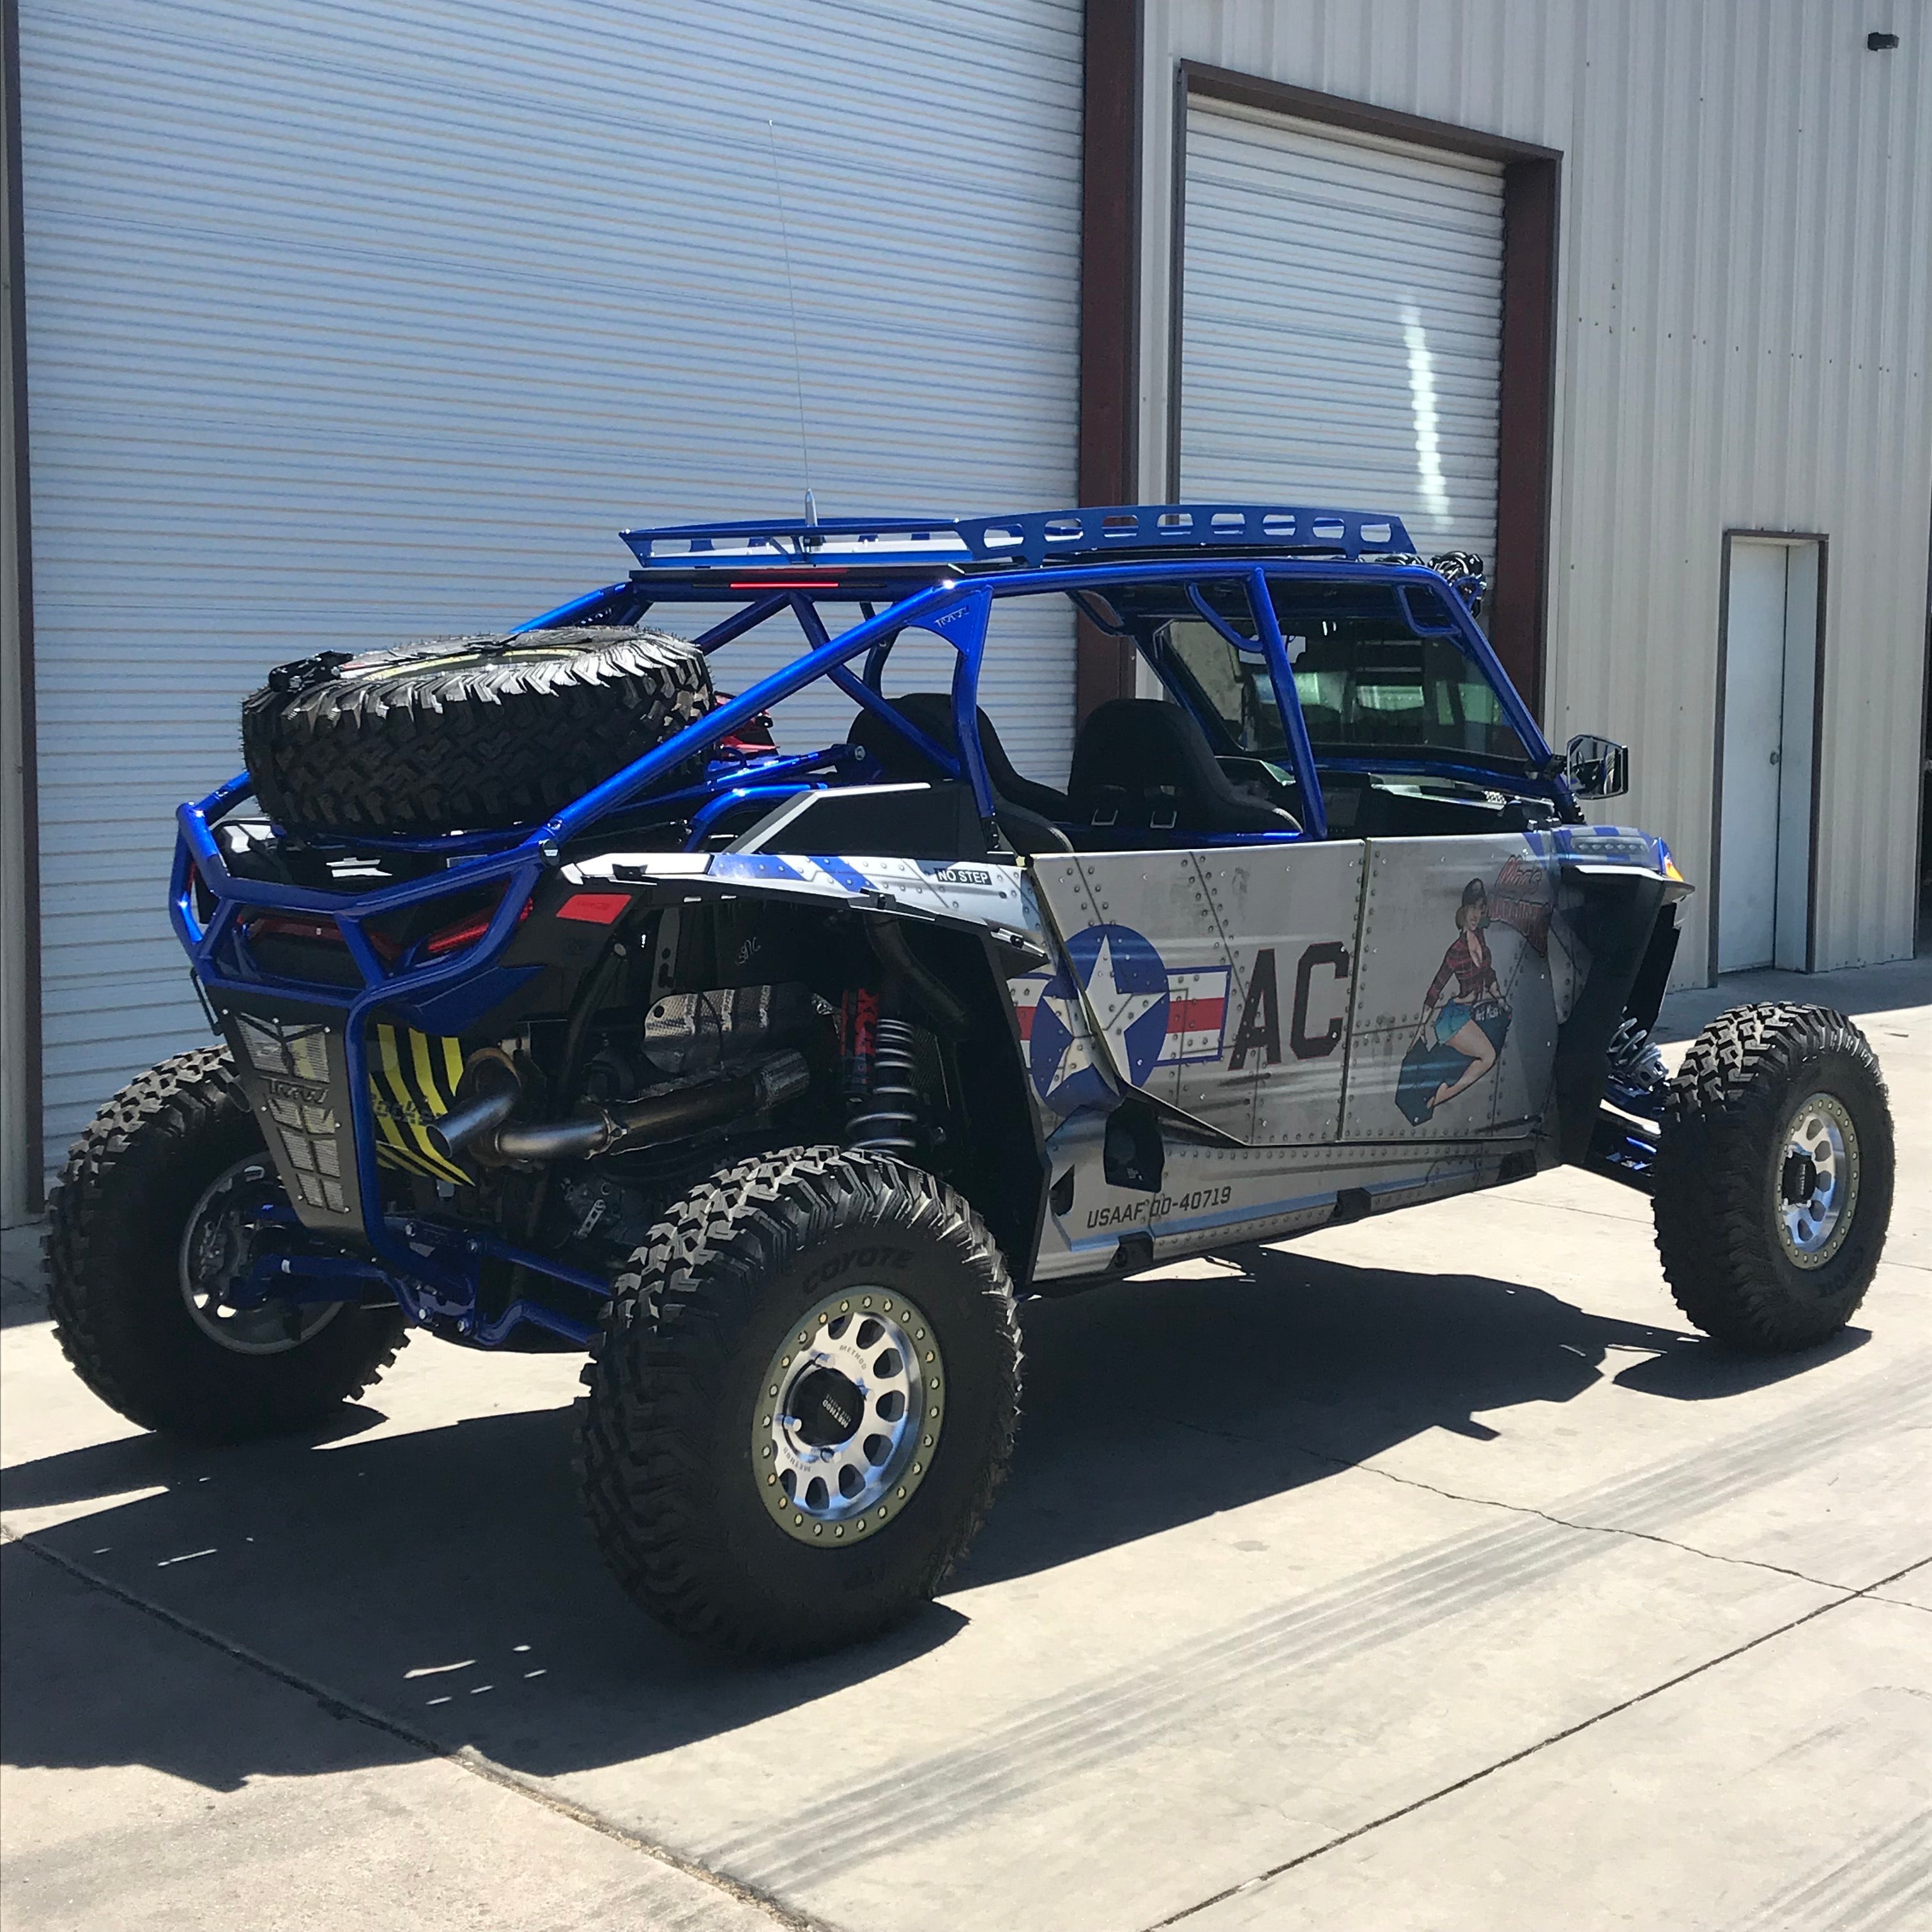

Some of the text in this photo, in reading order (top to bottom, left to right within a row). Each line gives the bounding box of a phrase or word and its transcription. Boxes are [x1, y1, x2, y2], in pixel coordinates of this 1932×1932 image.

[937, 870, 989, 884] NO STEP
[1227, 940, 1351, 1071] AC
[1087, 1201, 1146, 1229] USAAF
[802, 1246, 915, 1294] COYOTE
[839, 1344, 867, 1370] METHOD
[822, 1400, 848, 1428] METHOD
